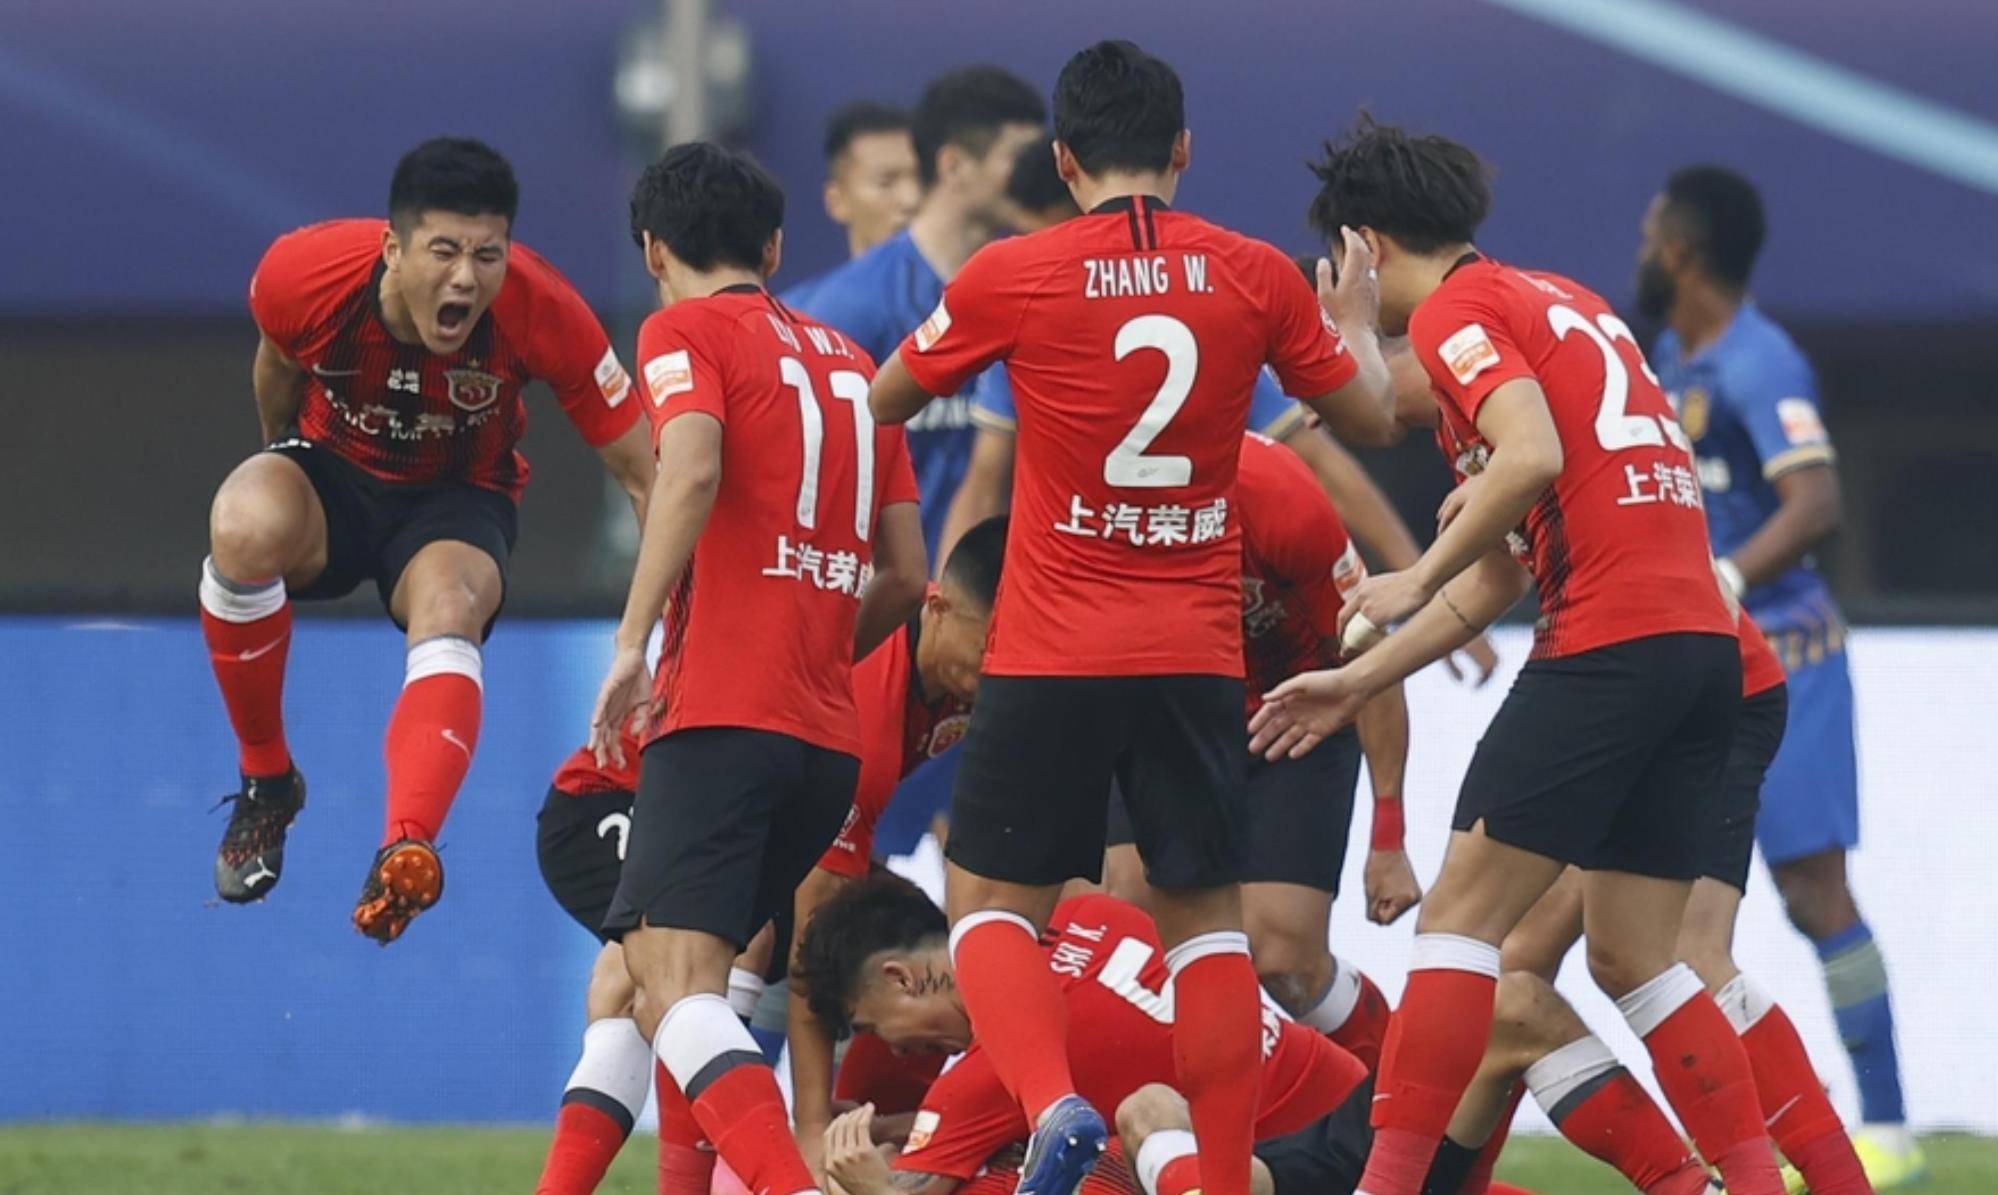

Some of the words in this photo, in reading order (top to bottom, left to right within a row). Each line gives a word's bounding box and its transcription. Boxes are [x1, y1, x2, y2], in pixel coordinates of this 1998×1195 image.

[1084, 256, 1168, 298] ZHANG
[1183, 254, 1214, 293] W.
[1103, 314, 1198, 488] 2
[780, 356, 875, 542] 11
[1617, 461, 1701, 510] 上汽荣
[1054, 495, 1228, 546] 上汽荣威
[1066, 922, 1107, 943] K.
[1050, 942, 1094, 978] SHI
